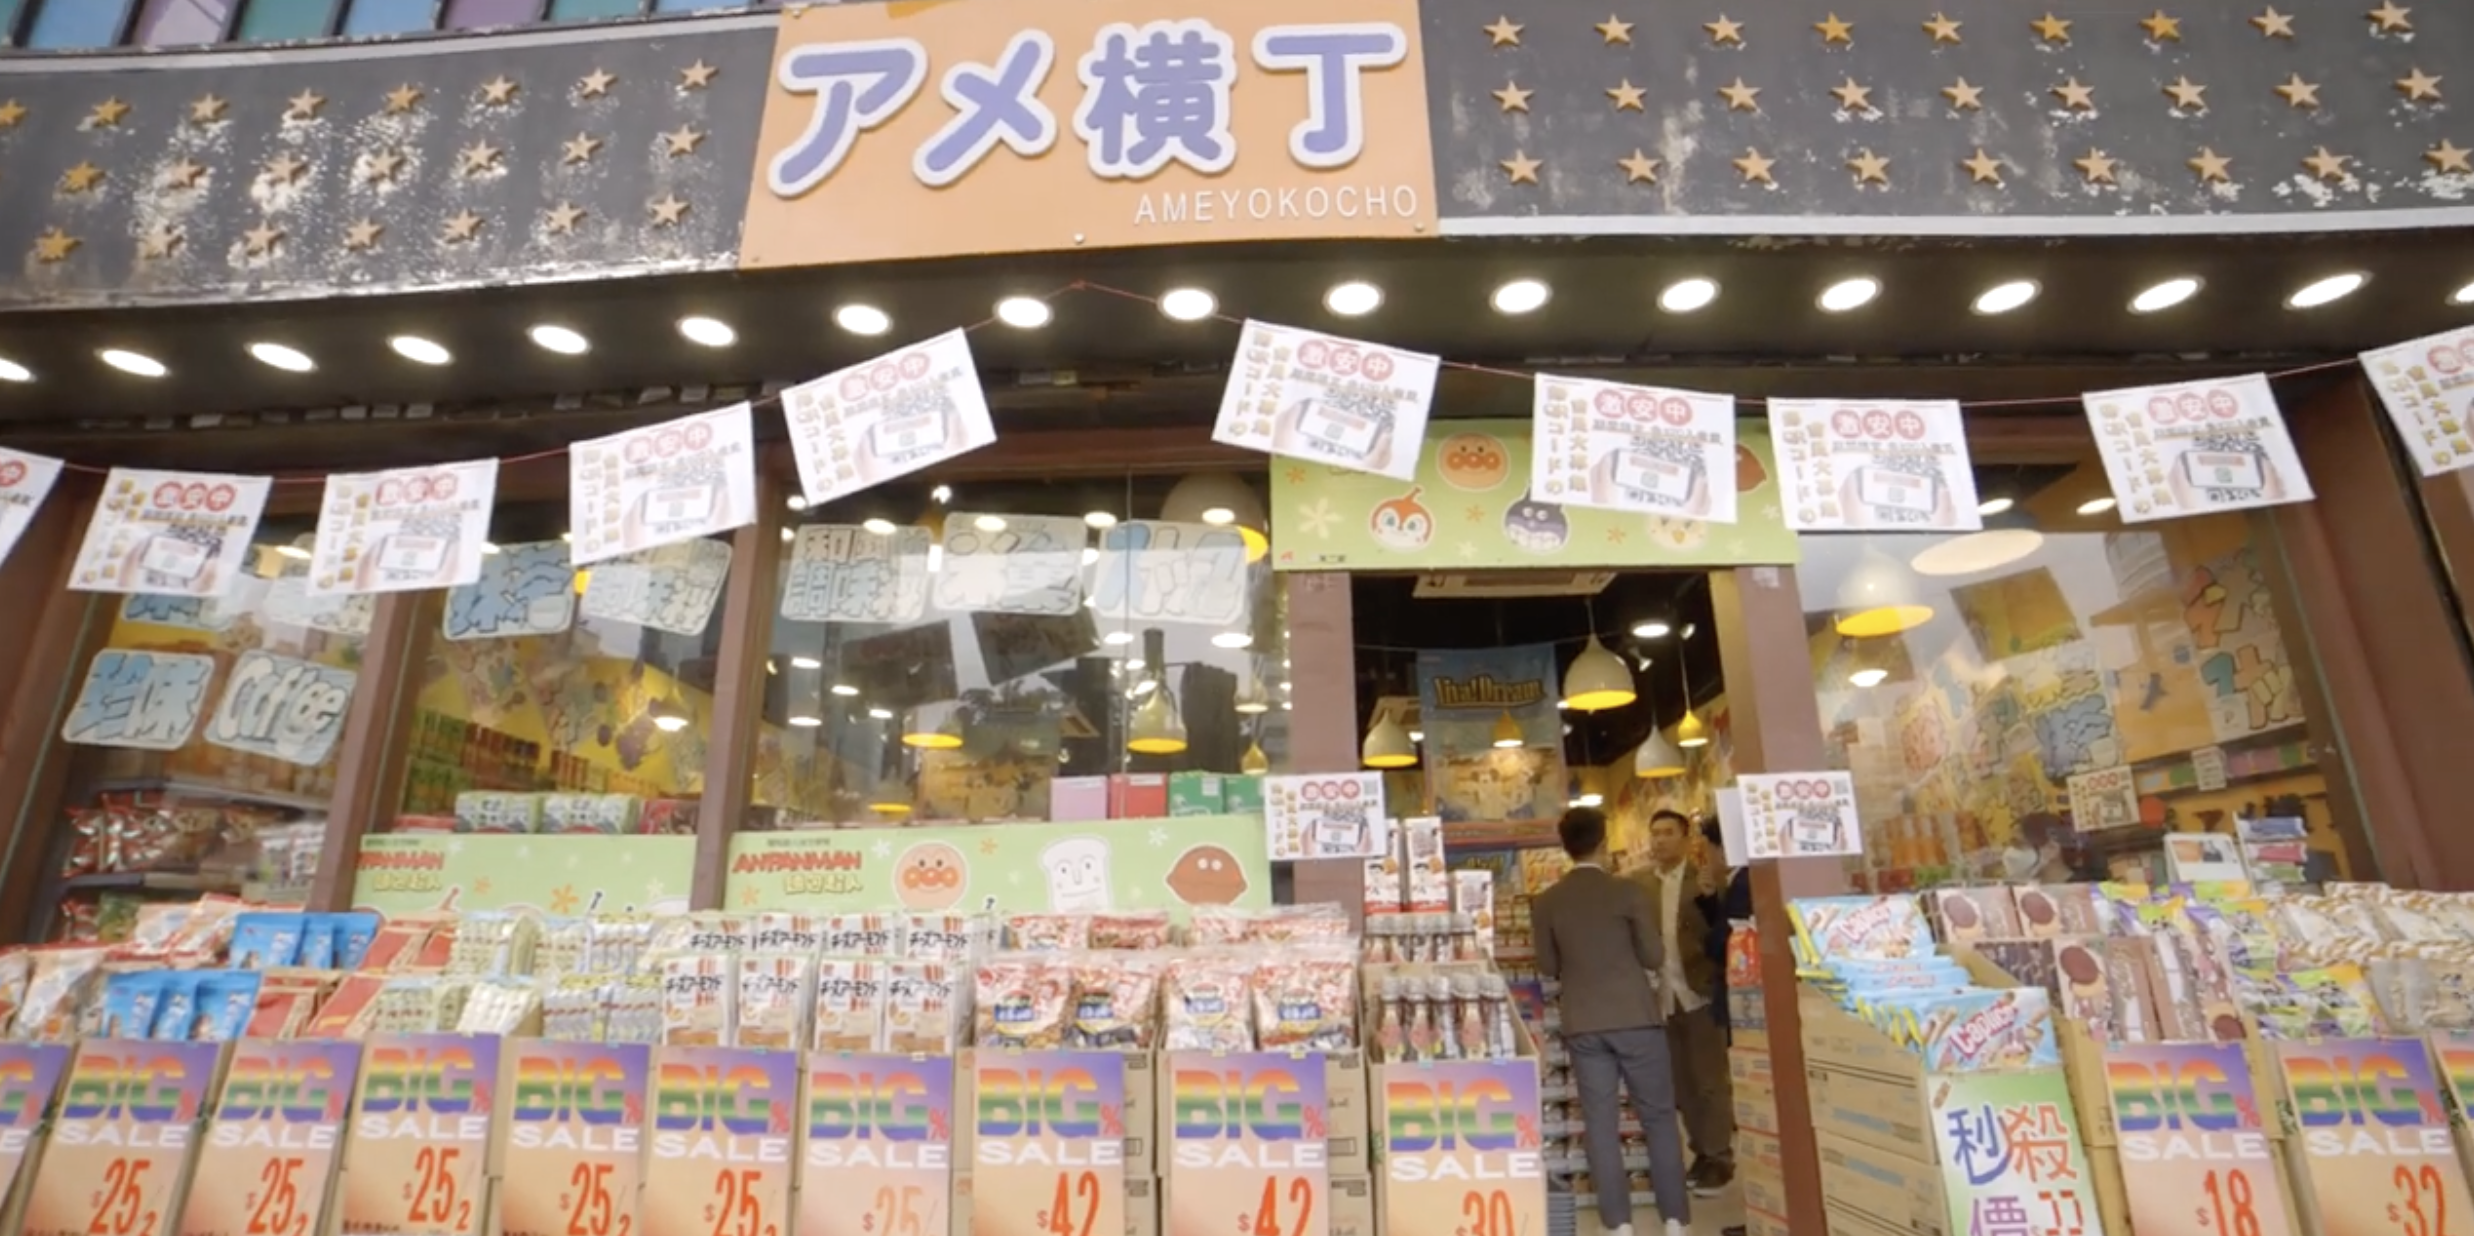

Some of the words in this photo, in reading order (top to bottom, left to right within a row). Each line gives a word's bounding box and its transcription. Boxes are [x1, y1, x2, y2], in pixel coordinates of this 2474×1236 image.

[768, 18, 1407, 198] アメ横丁
[1134, 184, 1418, 225] AMEYOKOCHO
[732, 851, 861, 873] ANPANMAN
[63, 1055, 186, 1121] BIG
[219, 1056, 333, 1122] BIG
[362, 1046, 474, 1113] BIG
[514, 1056, 625, 1124] BIG
[656, 1064, 770, 1135] BIG
[978, 1067, 1100, 1138] BIG
[1175, 1069, 1302, 1141] BIG
[2107, 1058, 2237, 1131] BIG
[2282, 1053, 2422, 1127] BIG
[358, 1116, 488, 1139] SALE
[809, 1072, 927, 1142] BIG
[1387, 1077, 1516, 1151] BIG
[57, 1123, 190, 1147] SALE
[210, 1123, 337, 1149] SALE
[512, 1123, 639, 1151] SALE
[653, 1134, 788, 1163] SALE
[808, 1141, 948, 1169] SALE
[978, 1140, 1122, 1165] SALE
[1176, 1142, 1325, 1169] SALE
[1947, 1104, 2077, 1185] 秒殺
[2123, 1132, 2268, 1161] SALE
[2306, 1128, 2452, 1155] SALE
[1391, 1152, 1540, 1181] SALE
